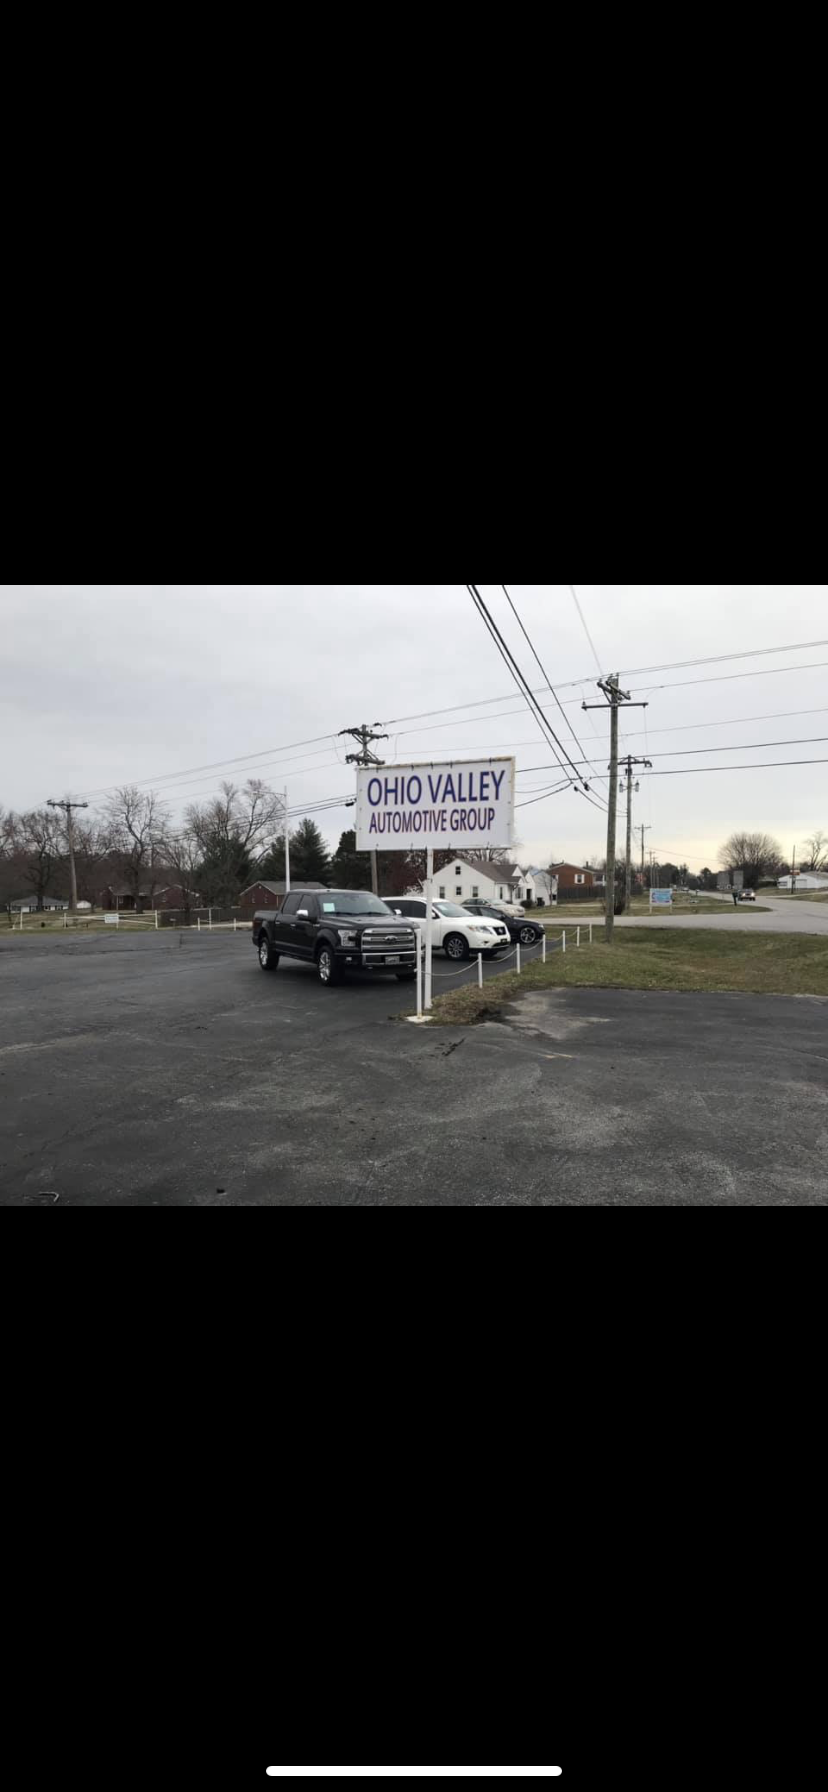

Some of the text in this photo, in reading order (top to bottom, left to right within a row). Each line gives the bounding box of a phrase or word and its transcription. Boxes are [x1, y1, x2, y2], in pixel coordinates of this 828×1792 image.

[367, 770, 505, 806] OHIO VALLEY
[369, 807, 495, 834] AUTOMOTIVE GROUP
